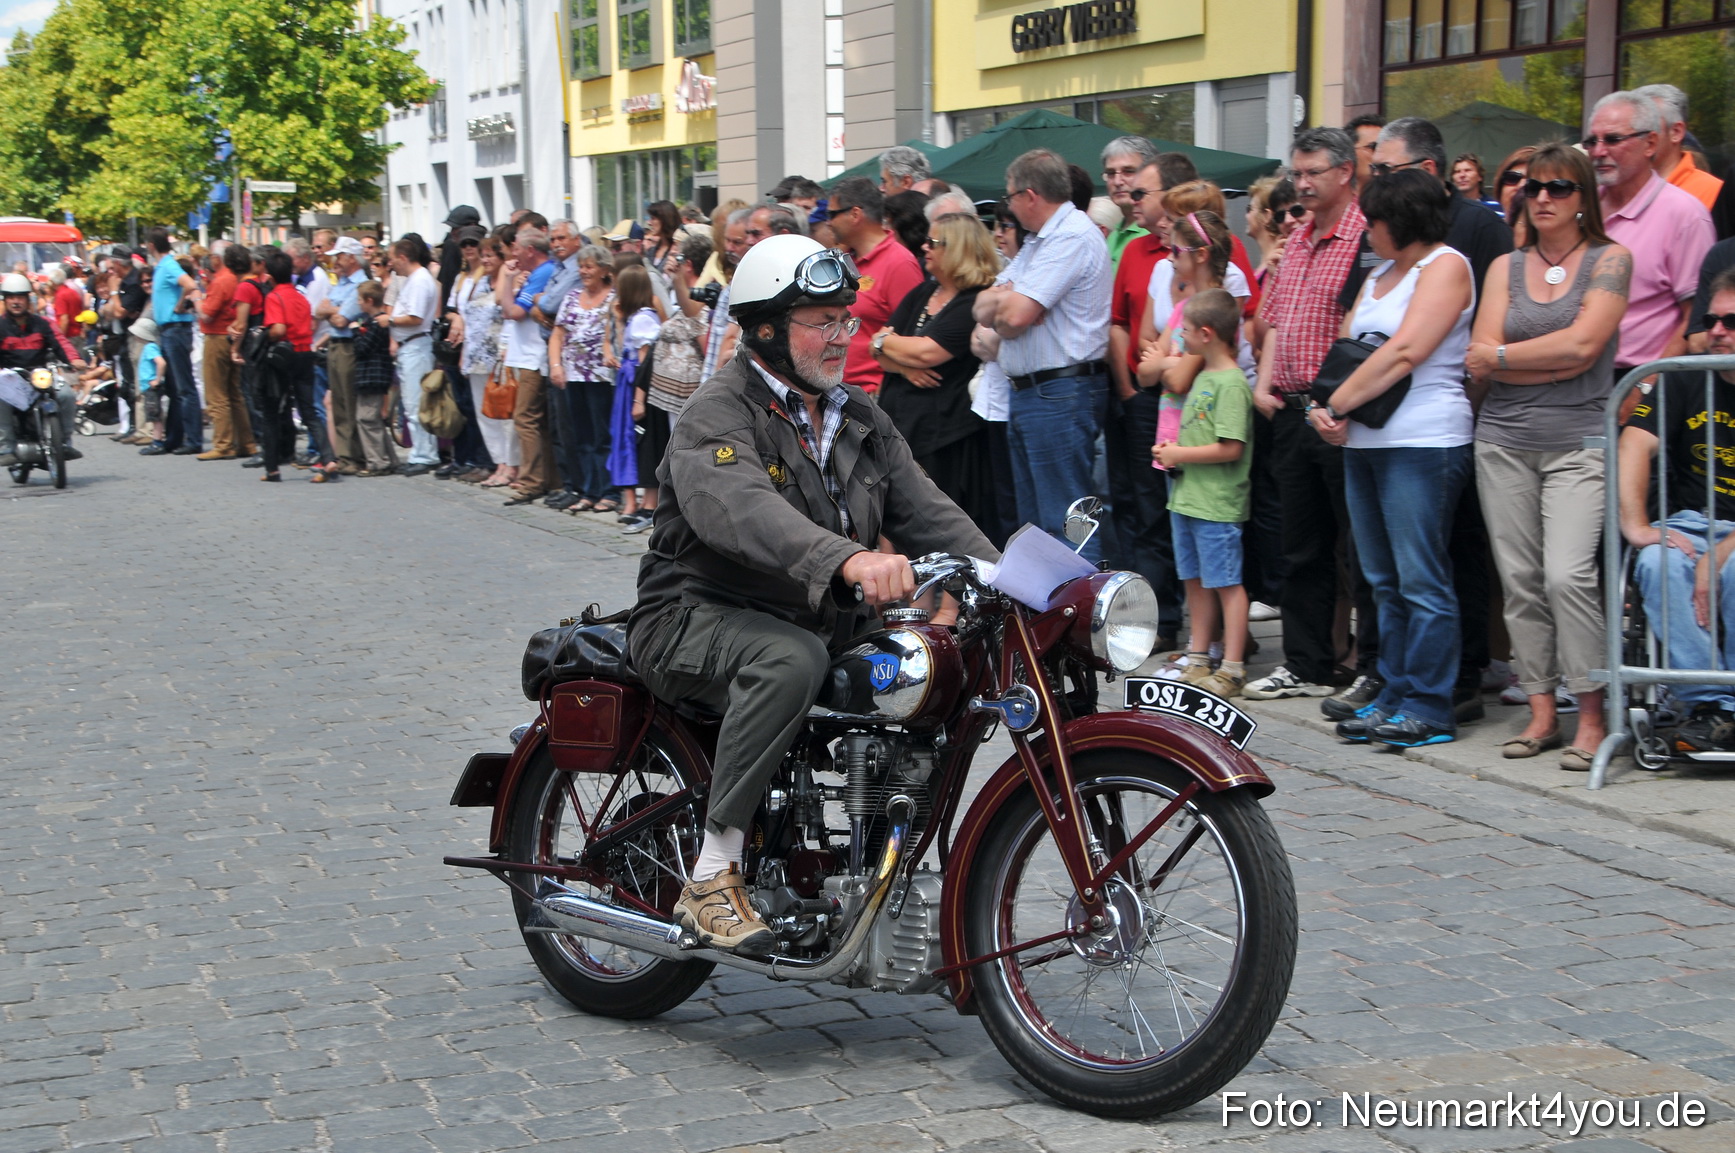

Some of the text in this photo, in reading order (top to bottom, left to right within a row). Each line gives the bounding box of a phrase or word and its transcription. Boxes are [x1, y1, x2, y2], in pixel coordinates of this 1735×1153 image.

[1012, 0, 1137, 53] GERRY WEBER
[872, 663, 895, 680] NSU
[1140, 682, 1238, 733] OSL 251
